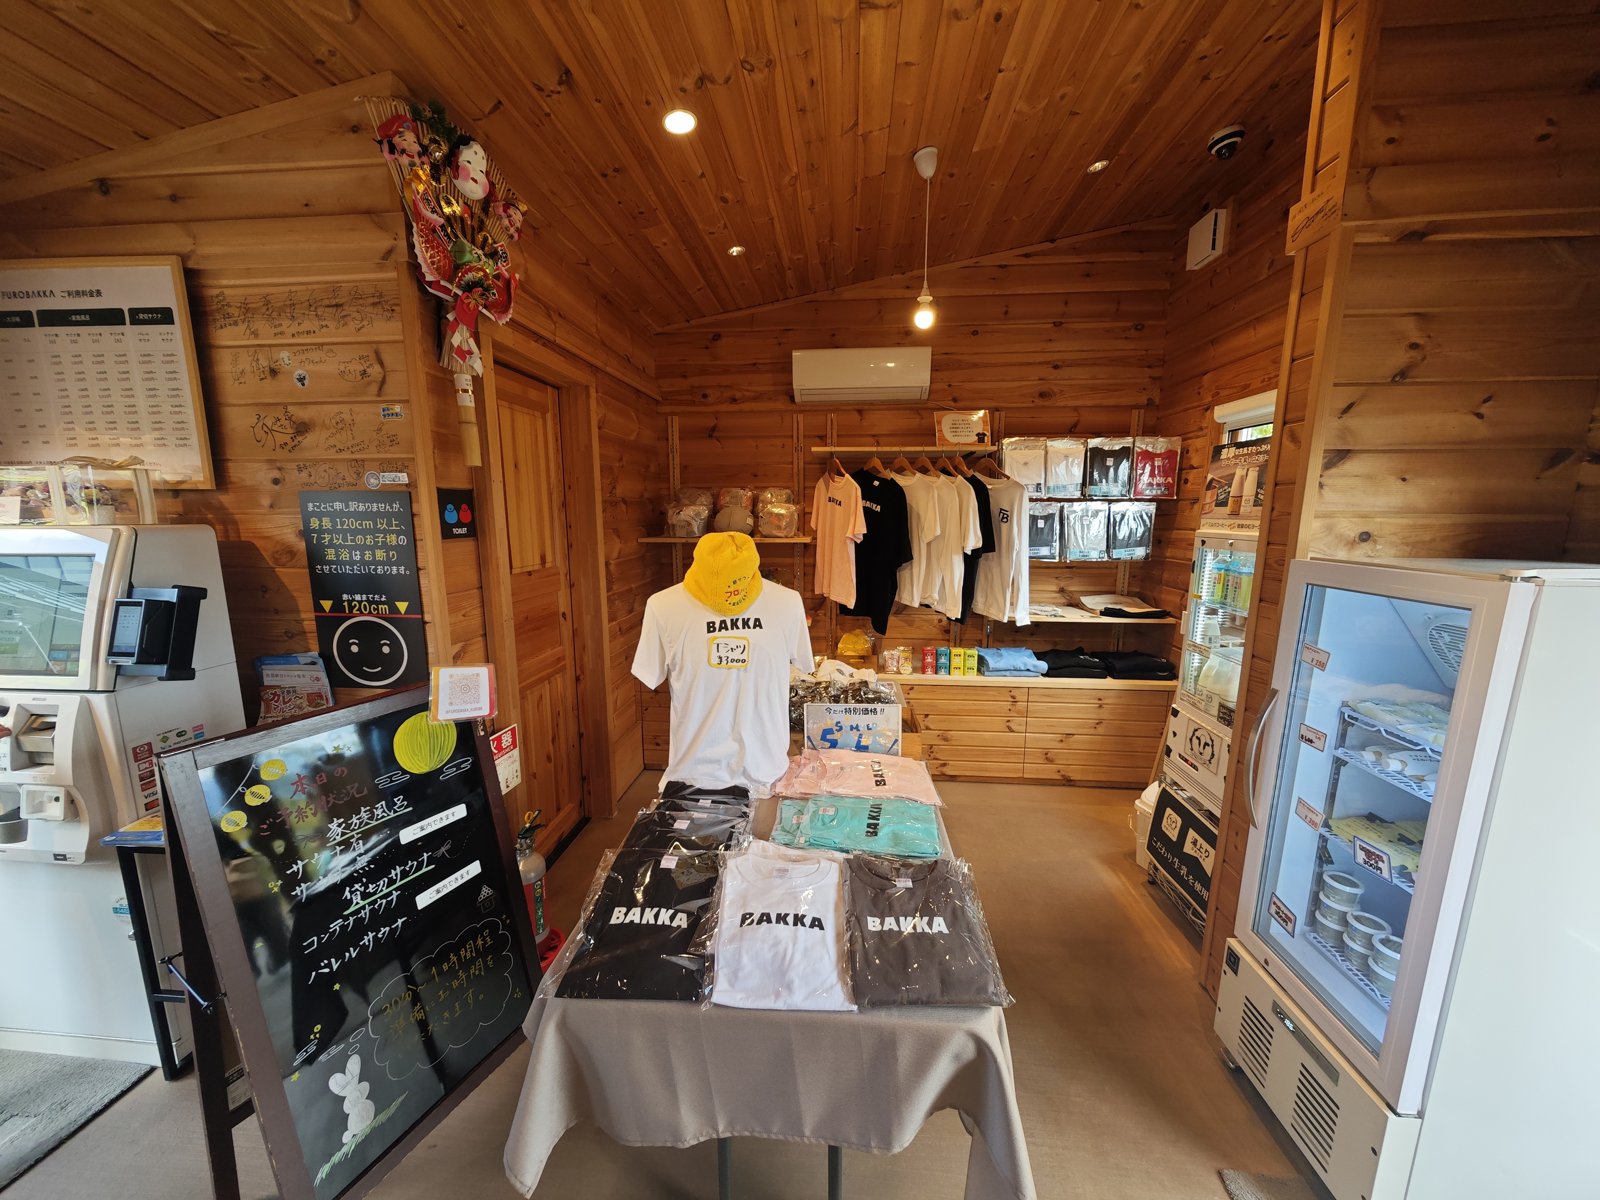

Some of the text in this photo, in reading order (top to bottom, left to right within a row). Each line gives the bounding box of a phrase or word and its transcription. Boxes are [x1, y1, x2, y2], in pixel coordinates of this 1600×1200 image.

[307, 501, 404, 512] まことに申し訳ありませんが、
[309, 517, 332, 529] 身長
[336, 518, 374, 529] 120cm
[452, 527, 467, 535] TOILET
[315, 564, 410, 575] させていただいております。
[343, 601, 390, 615] 120cm
[706, 617, 763, 634] BAKKA
[290, 767, 348, 799] 本日の
[260, 782, 368, 836] ご予約状況
[326, 795, 409, 841] 家族風呂
[412, 811, 456, 836] ご案内できます
[342, 852, 432, 908] 貸切サウナ
[1151, 837, 1209, 902] こだわり生乳を使用
[429, 869, 471, 900] ご案内できます
[303, 891, 401, 954] コンテナサウナ
[609, 906, 689, 929] BAKKA
[739, 911, 825, 931] BAKKA
[867, 916, 950, 934] BAKKA
[308, 917, 408, 985] バレルサウナ
